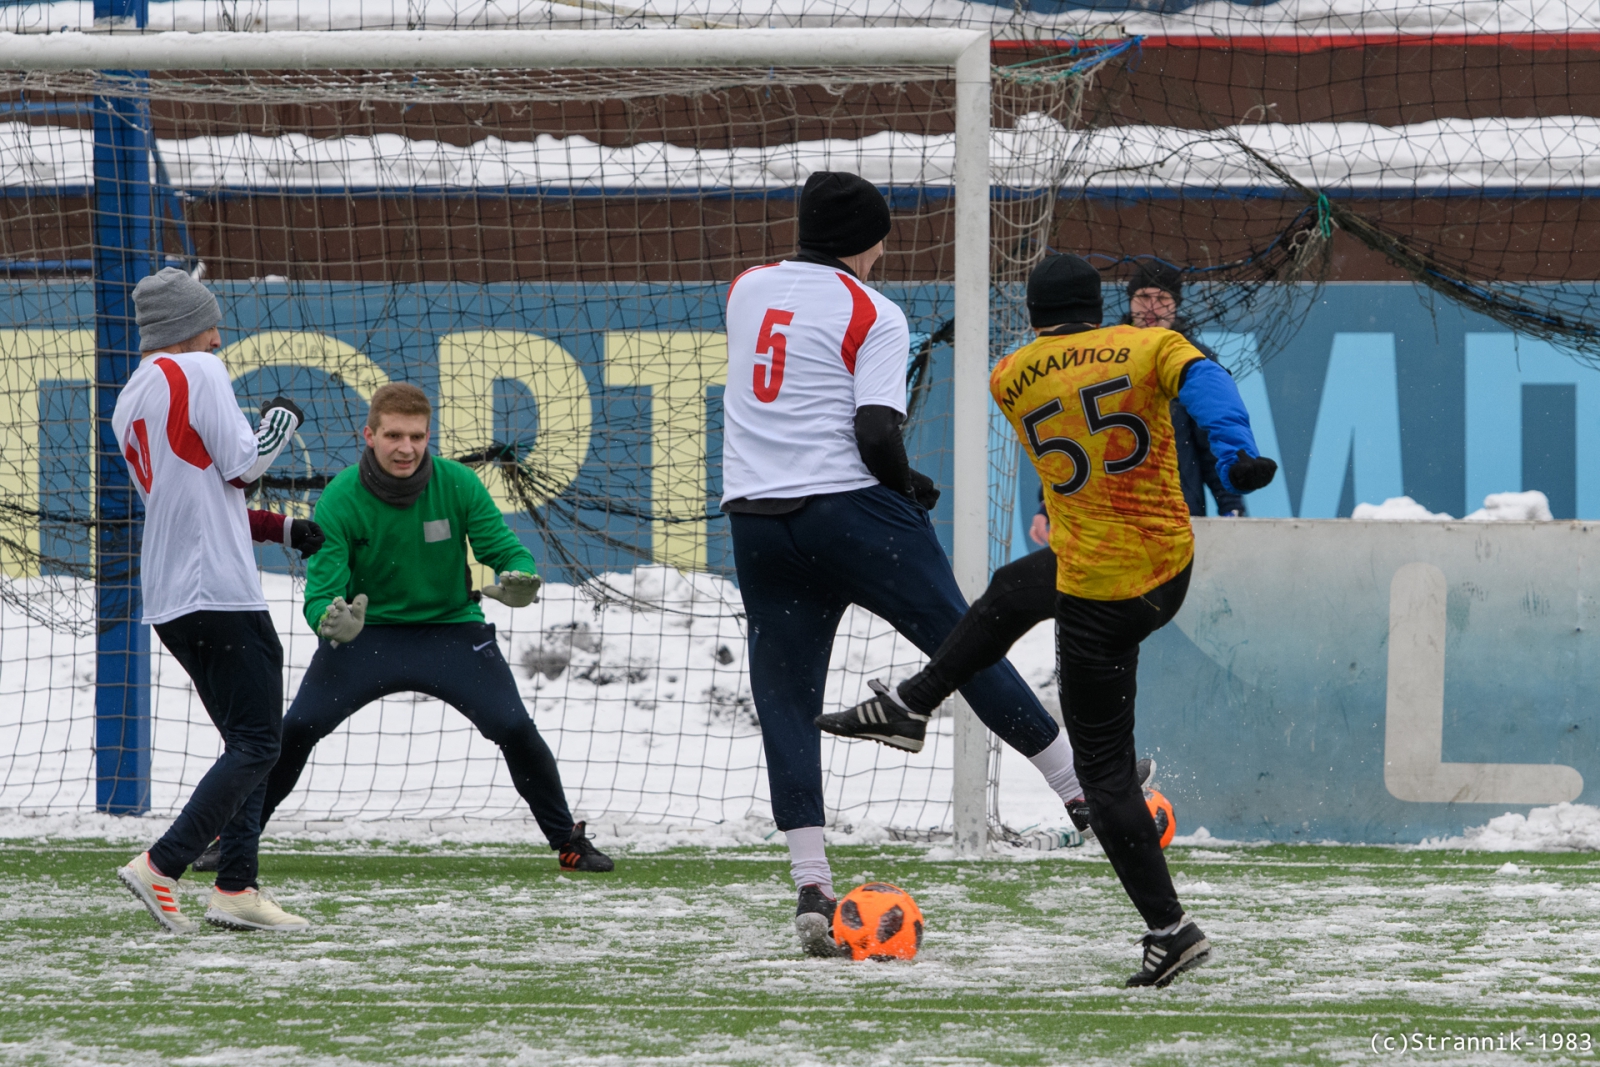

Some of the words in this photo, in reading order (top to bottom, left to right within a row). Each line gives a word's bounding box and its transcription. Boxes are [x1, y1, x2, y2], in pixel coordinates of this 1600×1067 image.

[752, 308, 795, 404] 5
[1001, 347, 1131, 413] МИХАЙЛОВ
[1020, 374, 1151, 496] 55
